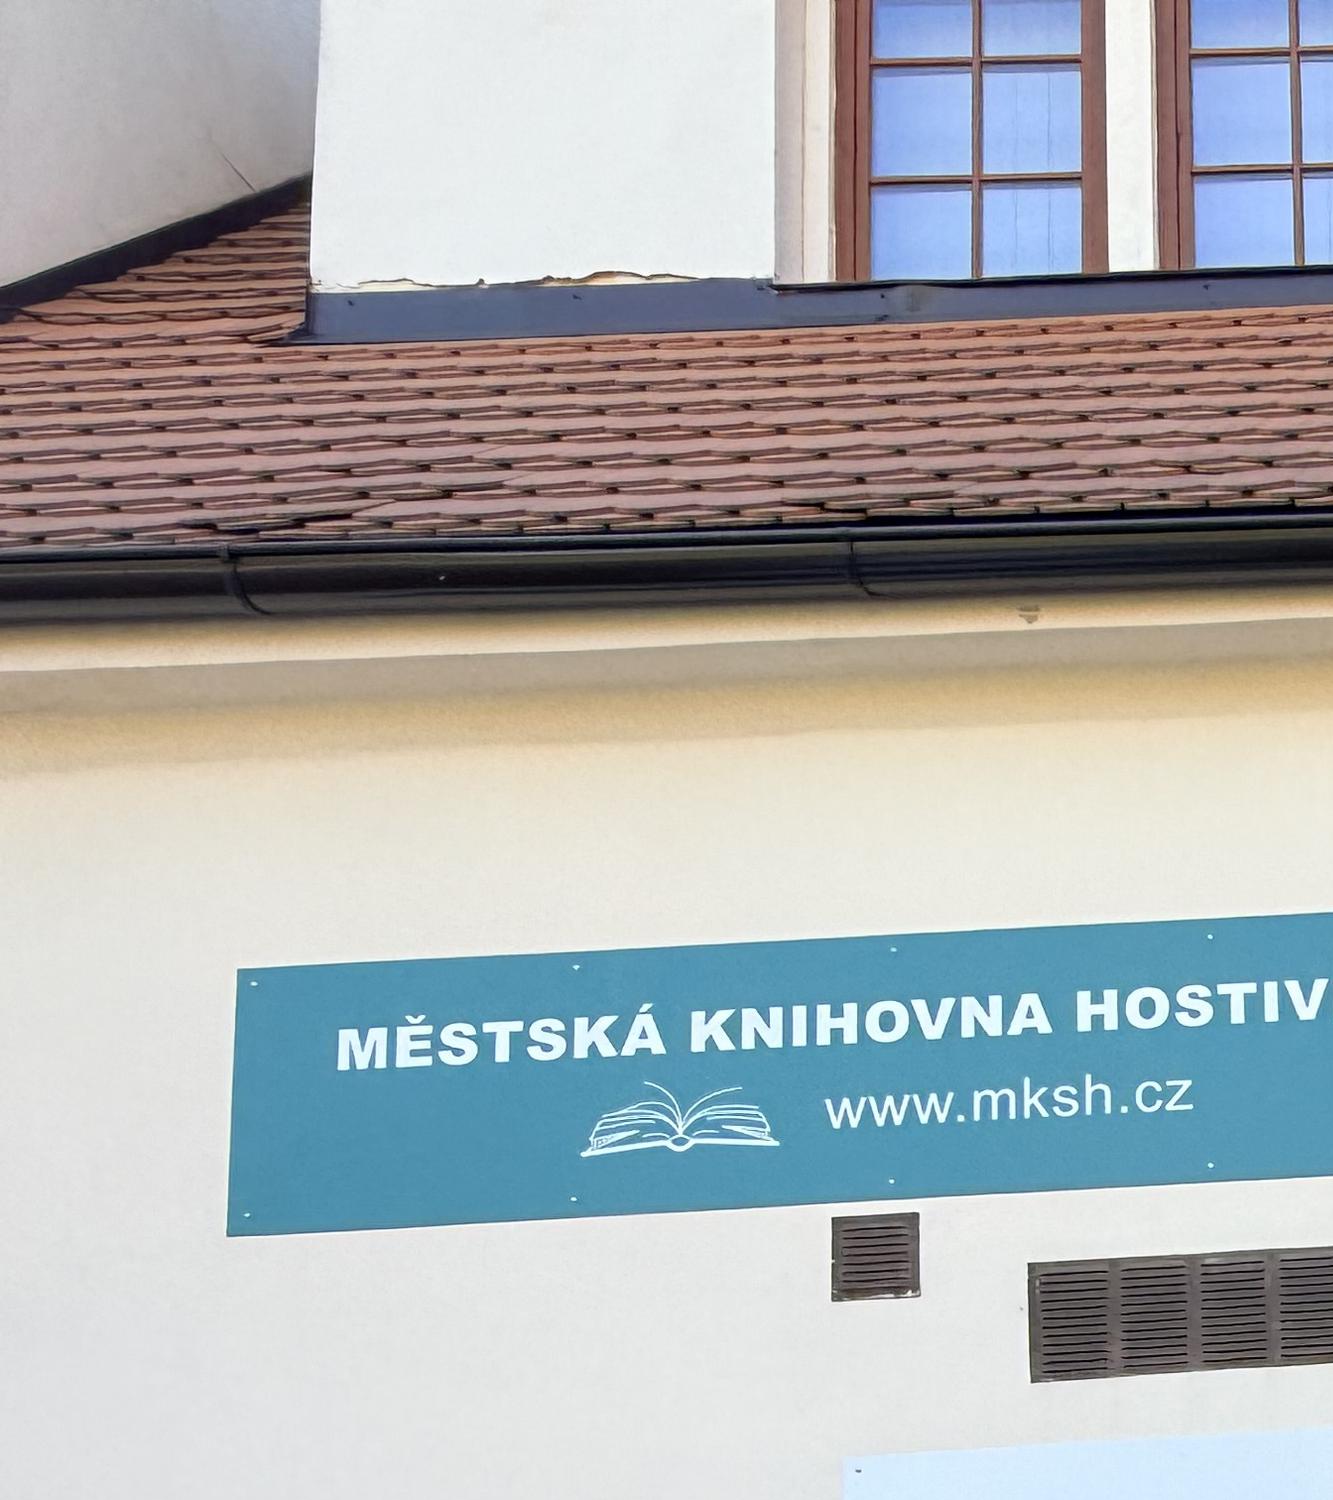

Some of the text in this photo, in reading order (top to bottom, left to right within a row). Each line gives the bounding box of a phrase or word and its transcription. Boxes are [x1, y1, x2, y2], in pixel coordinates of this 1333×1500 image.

[336, 1003, 667, 1072] MĚSTSKÁ
[690, 993, 1053, 1054] KNIHOVNA
[824, 1073, 1195, 1130] www.mksh.cz
